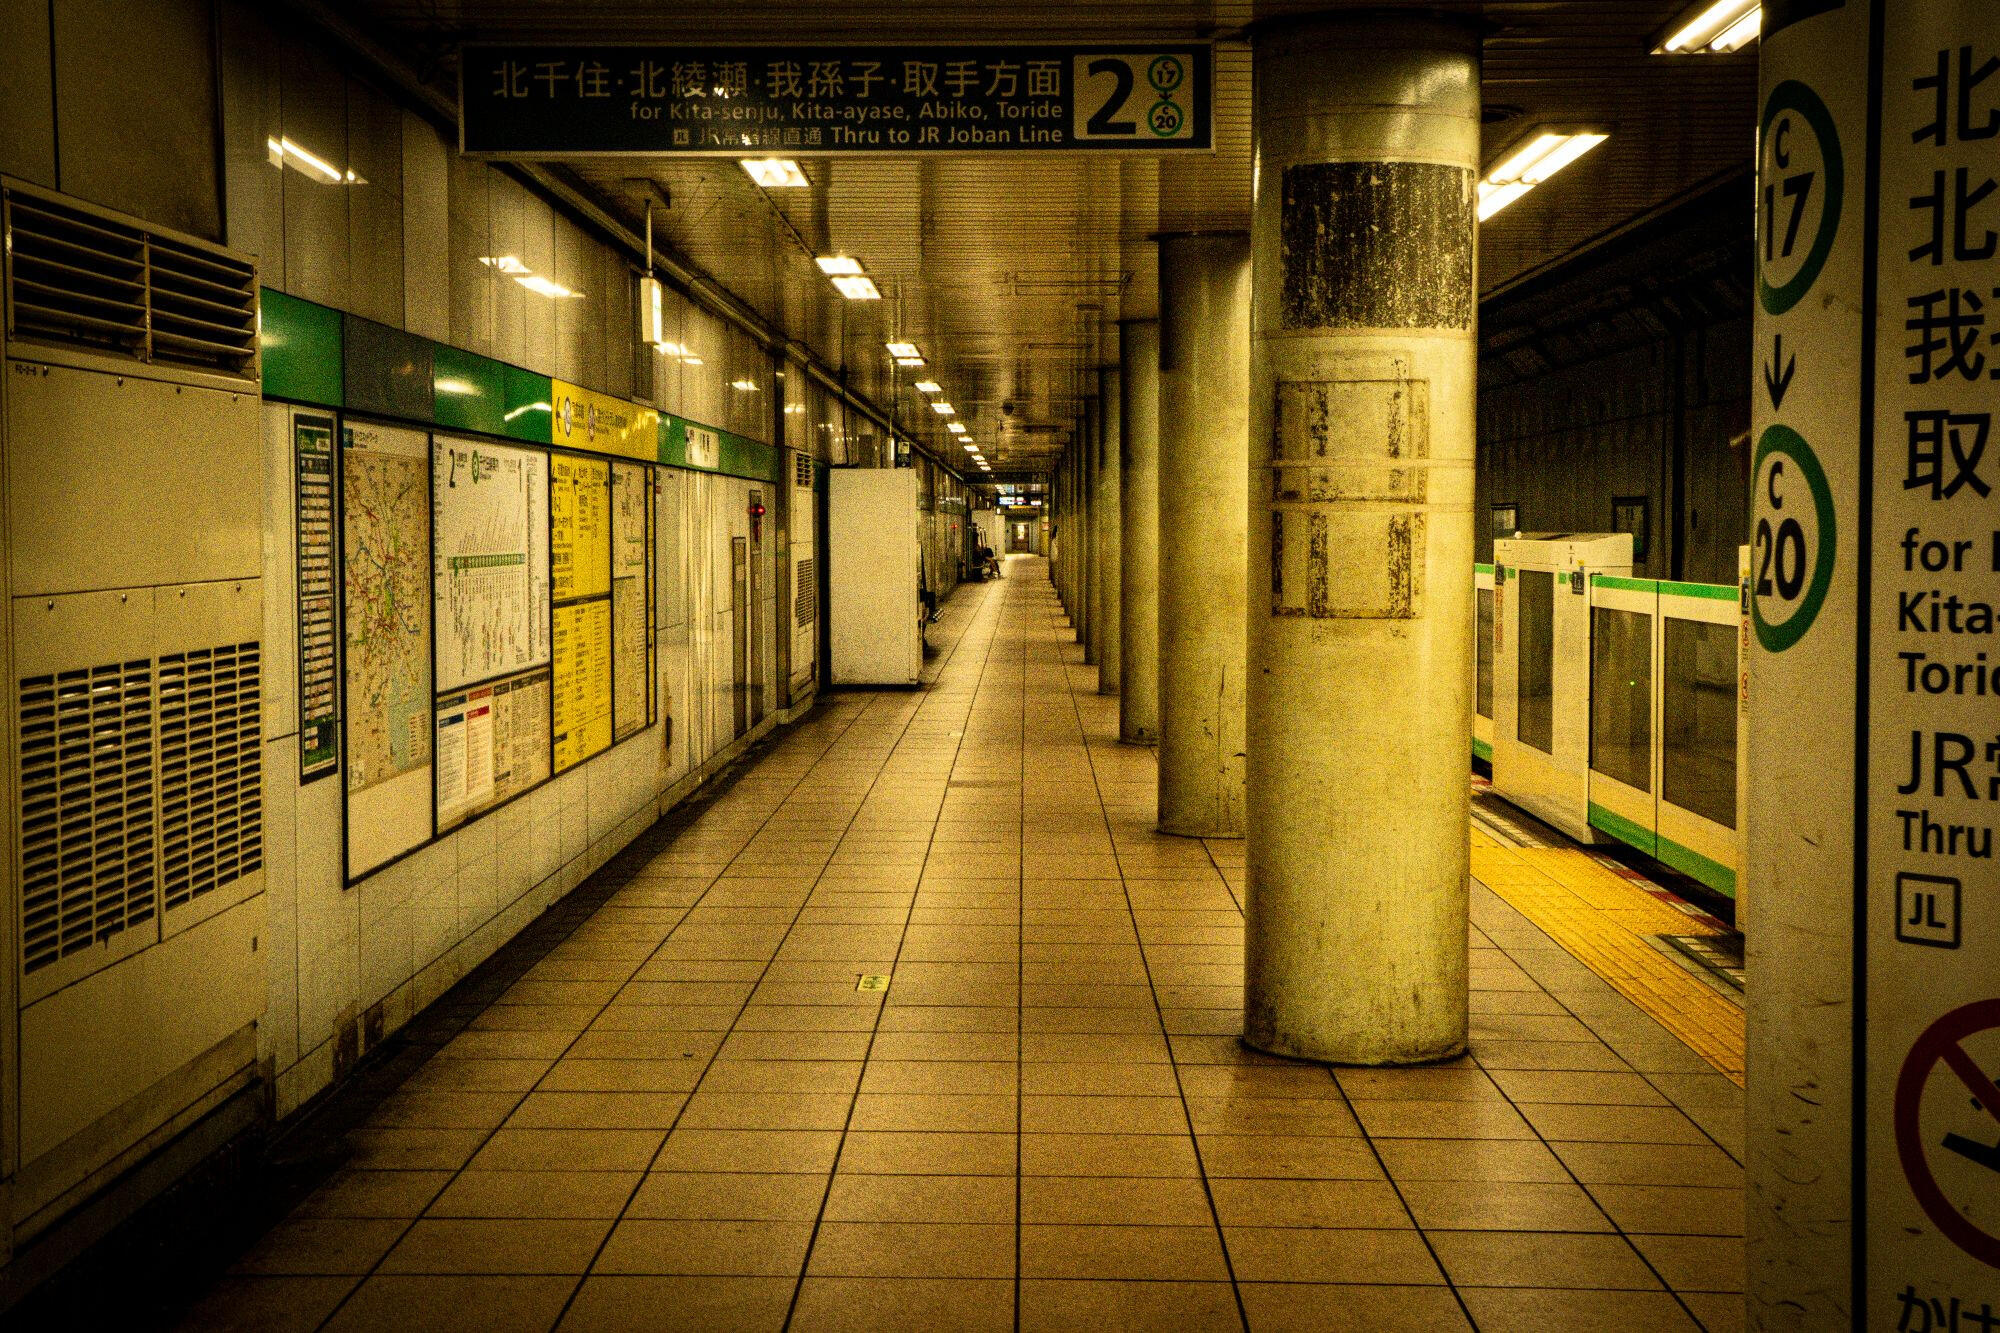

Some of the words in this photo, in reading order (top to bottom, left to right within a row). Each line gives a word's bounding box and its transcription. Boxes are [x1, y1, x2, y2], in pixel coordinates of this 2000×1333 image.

[1156, 70, 1176, 85] 17
[1162, 60, 1170, 70] C
[630, 102, 662, 120] for
[670, 102, 785, 123] Kita-senju,
[792, 101, 910, 124] Kita-ayase,
[918, 101, 988, 122] Abiko,
[996, 101, 1063, 120] Toride
[1086, 58, 1137, 135] 2
[1162, 106, 1169, 116] C
[830, 126, 879, 144] Thru
[887, 128, 911, 144] to
[917, 126, 940, 144] JR
[947, 126, 1011, 144] Joban
[1019, 126, 1063, 144] Line
[1154, 115, 1177, 129] 20
[1775, 118, 1790, 169] C
[1765, 171, 1815, 262] 17
[1905, 288, 2000, 385] 我
[1769, 461, 1783, 510] C
[1757, 517, 1806, 600] 20
[1901, 527, 1972, 572] for
[1896, 810, 1991, 859] Thru
[1908, 892, 1946, 929] JL
